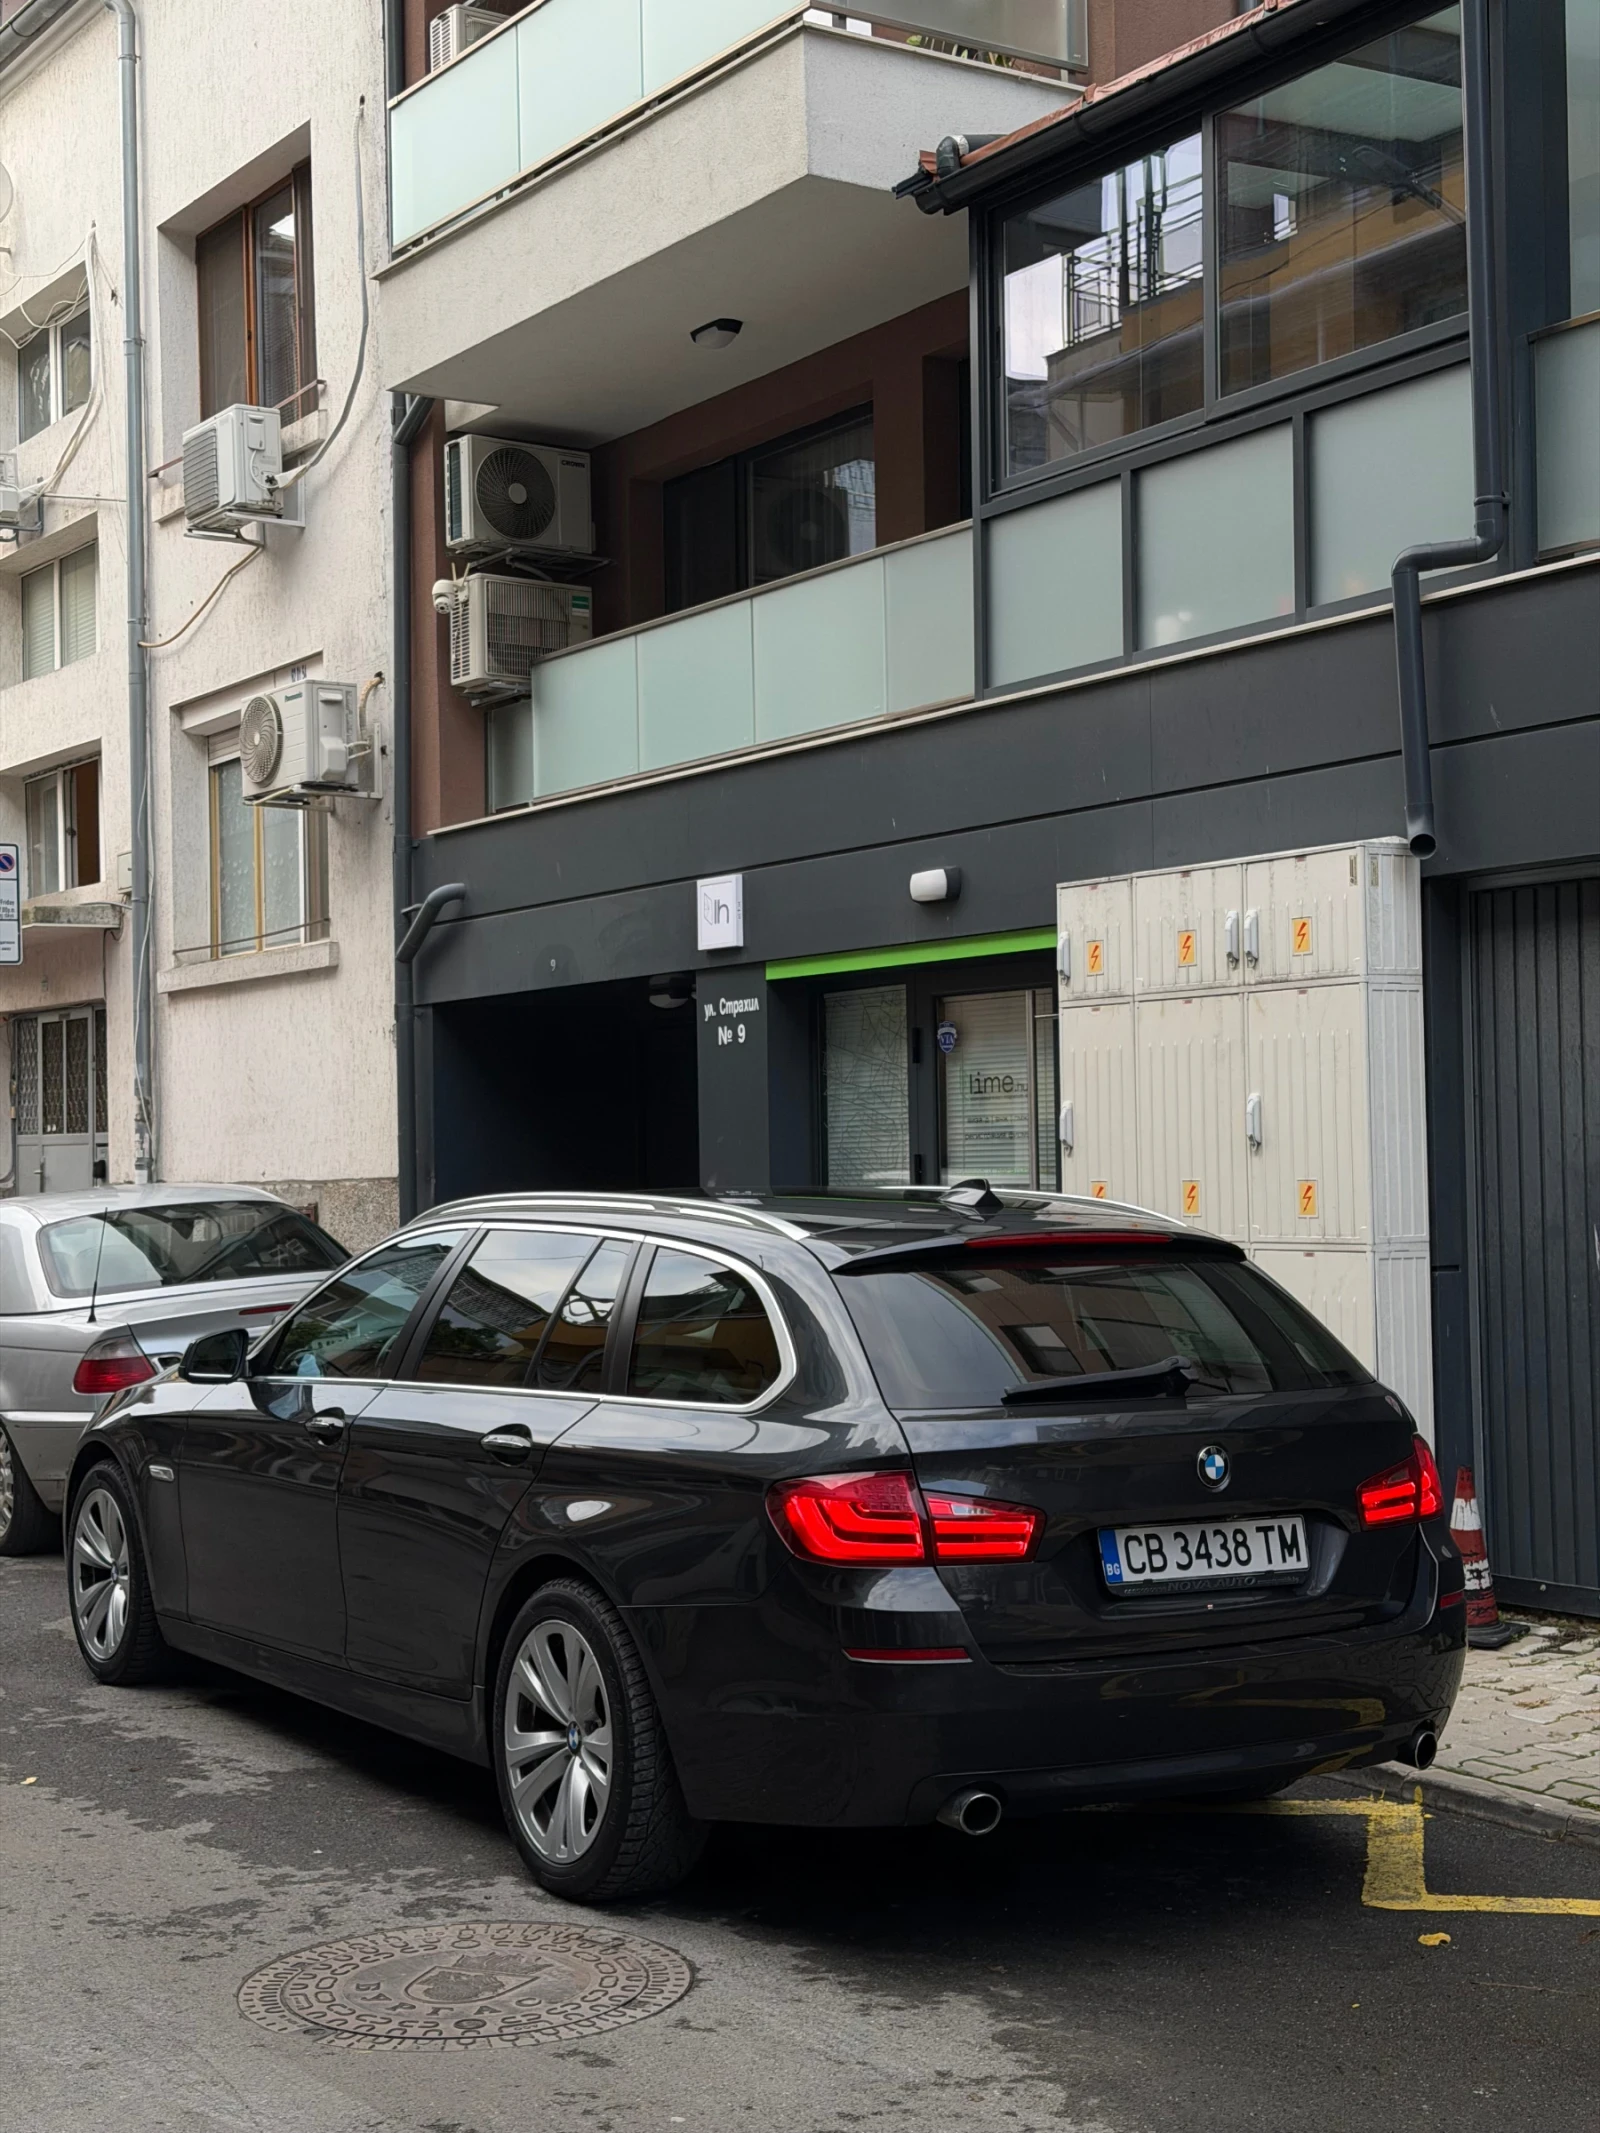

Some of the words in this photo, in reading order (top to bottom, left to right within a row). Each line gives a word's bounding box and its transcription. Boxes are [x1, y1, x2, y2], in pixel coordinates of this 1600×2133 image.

[704, 1003, 717, 1022] ул.
[719, 997, 760, 1018] Страхил
[737, 1023, 746, 1043] 9
[1124, 1533, 1168, 1574] CB
[1173, 1528, 1252, 1571] 3438
[1255, 1523, 1301, 1565] TM
[1106, 1563, 1121, 1576] BG
